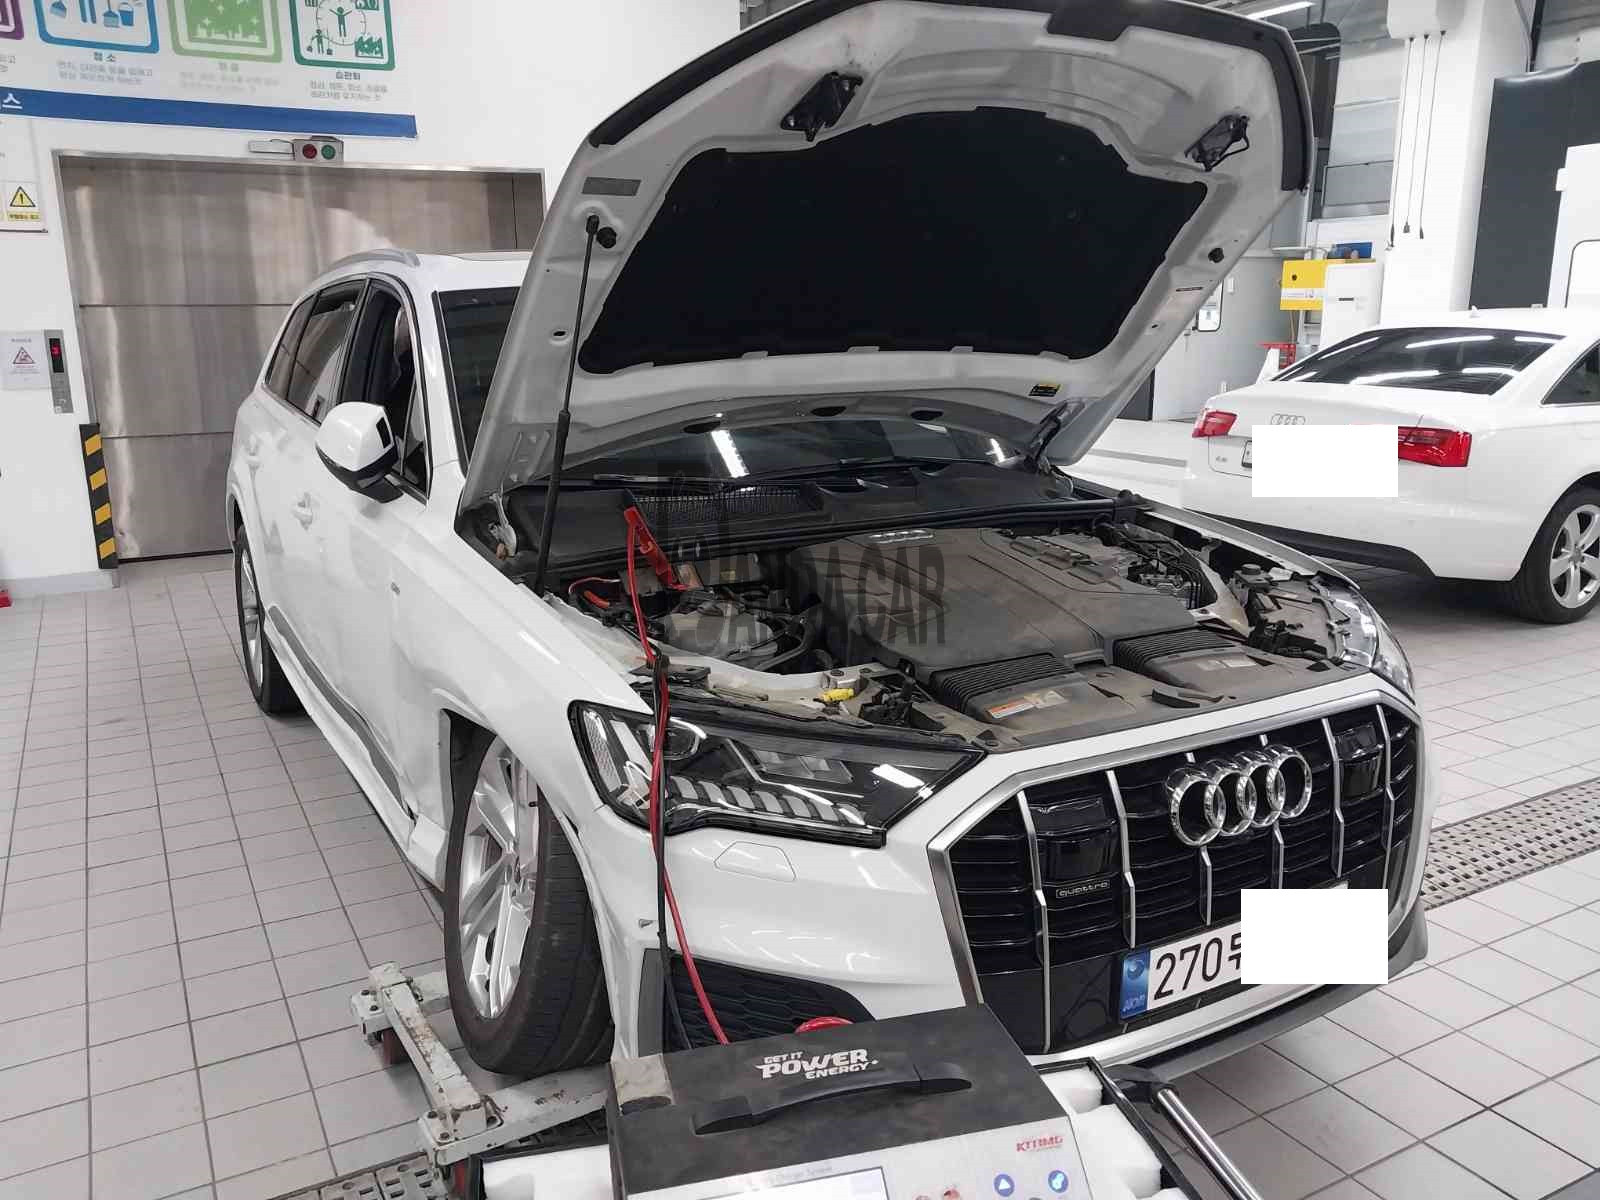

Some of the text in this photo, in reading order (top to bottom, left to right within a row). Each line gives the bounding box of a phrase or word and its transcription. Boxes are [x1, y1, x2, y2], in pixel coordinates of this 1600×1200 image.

[0, 92, 23, 109] 스
[1056, 880, 1110, 898] quattro
[754, 1048, 868, 1079] POWER
[763, 1051, 804, 1065] GET IT
[804, 1061, 870, 1080] ENERGY
